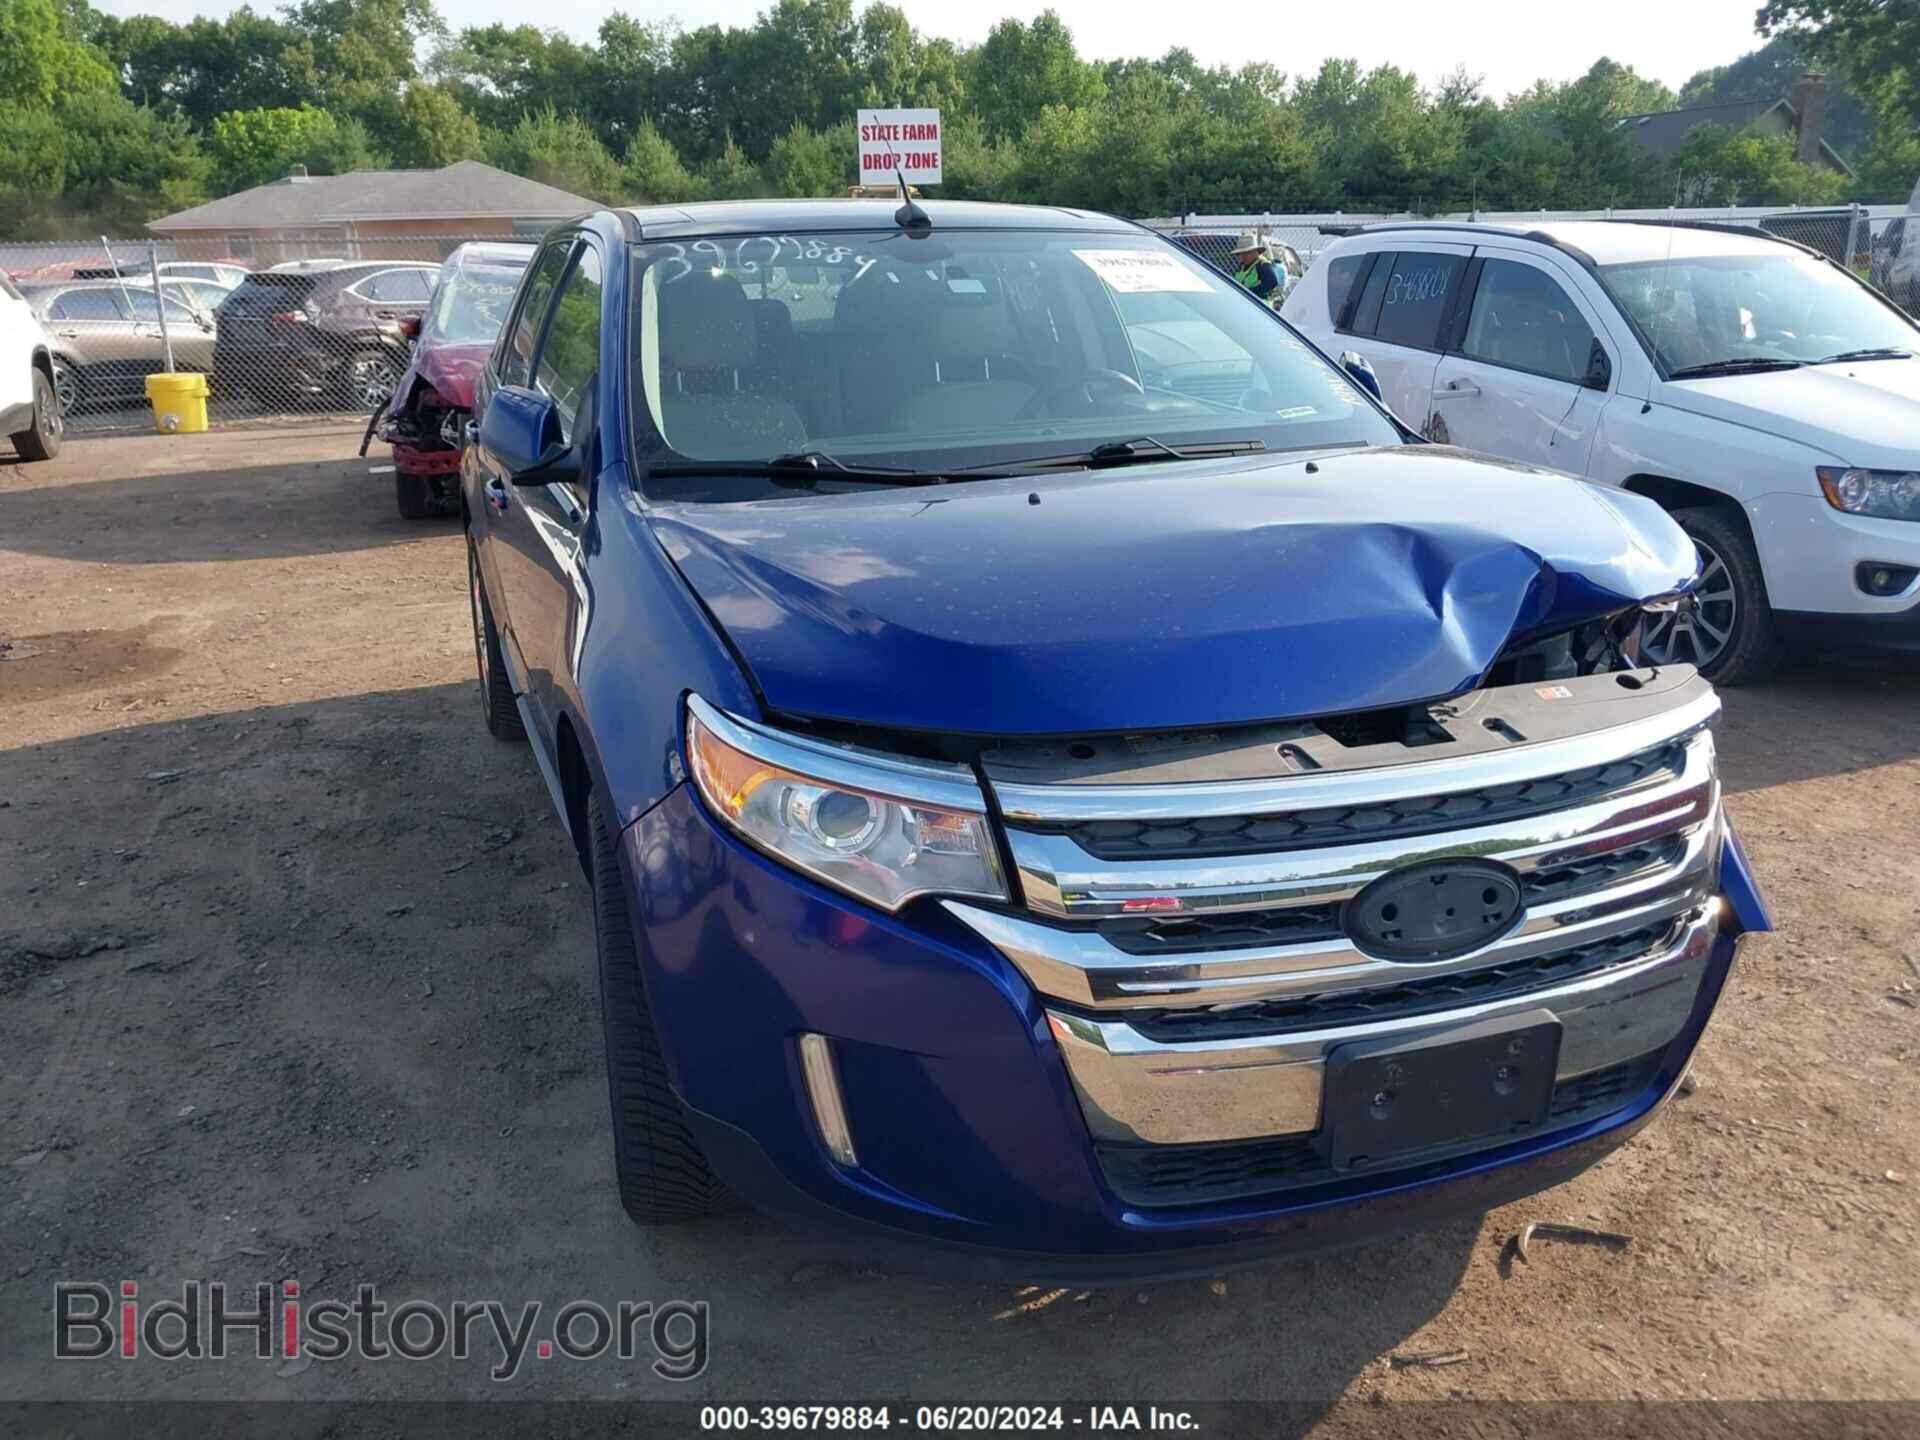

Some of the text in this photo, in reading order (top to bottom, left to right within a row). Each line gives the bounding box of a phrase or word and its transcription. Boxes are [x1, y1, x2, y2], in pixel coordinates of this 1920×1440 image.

[862, 124, 937, 141] STATE FARM
[863, 152, 938, 170] DROP ZONE
